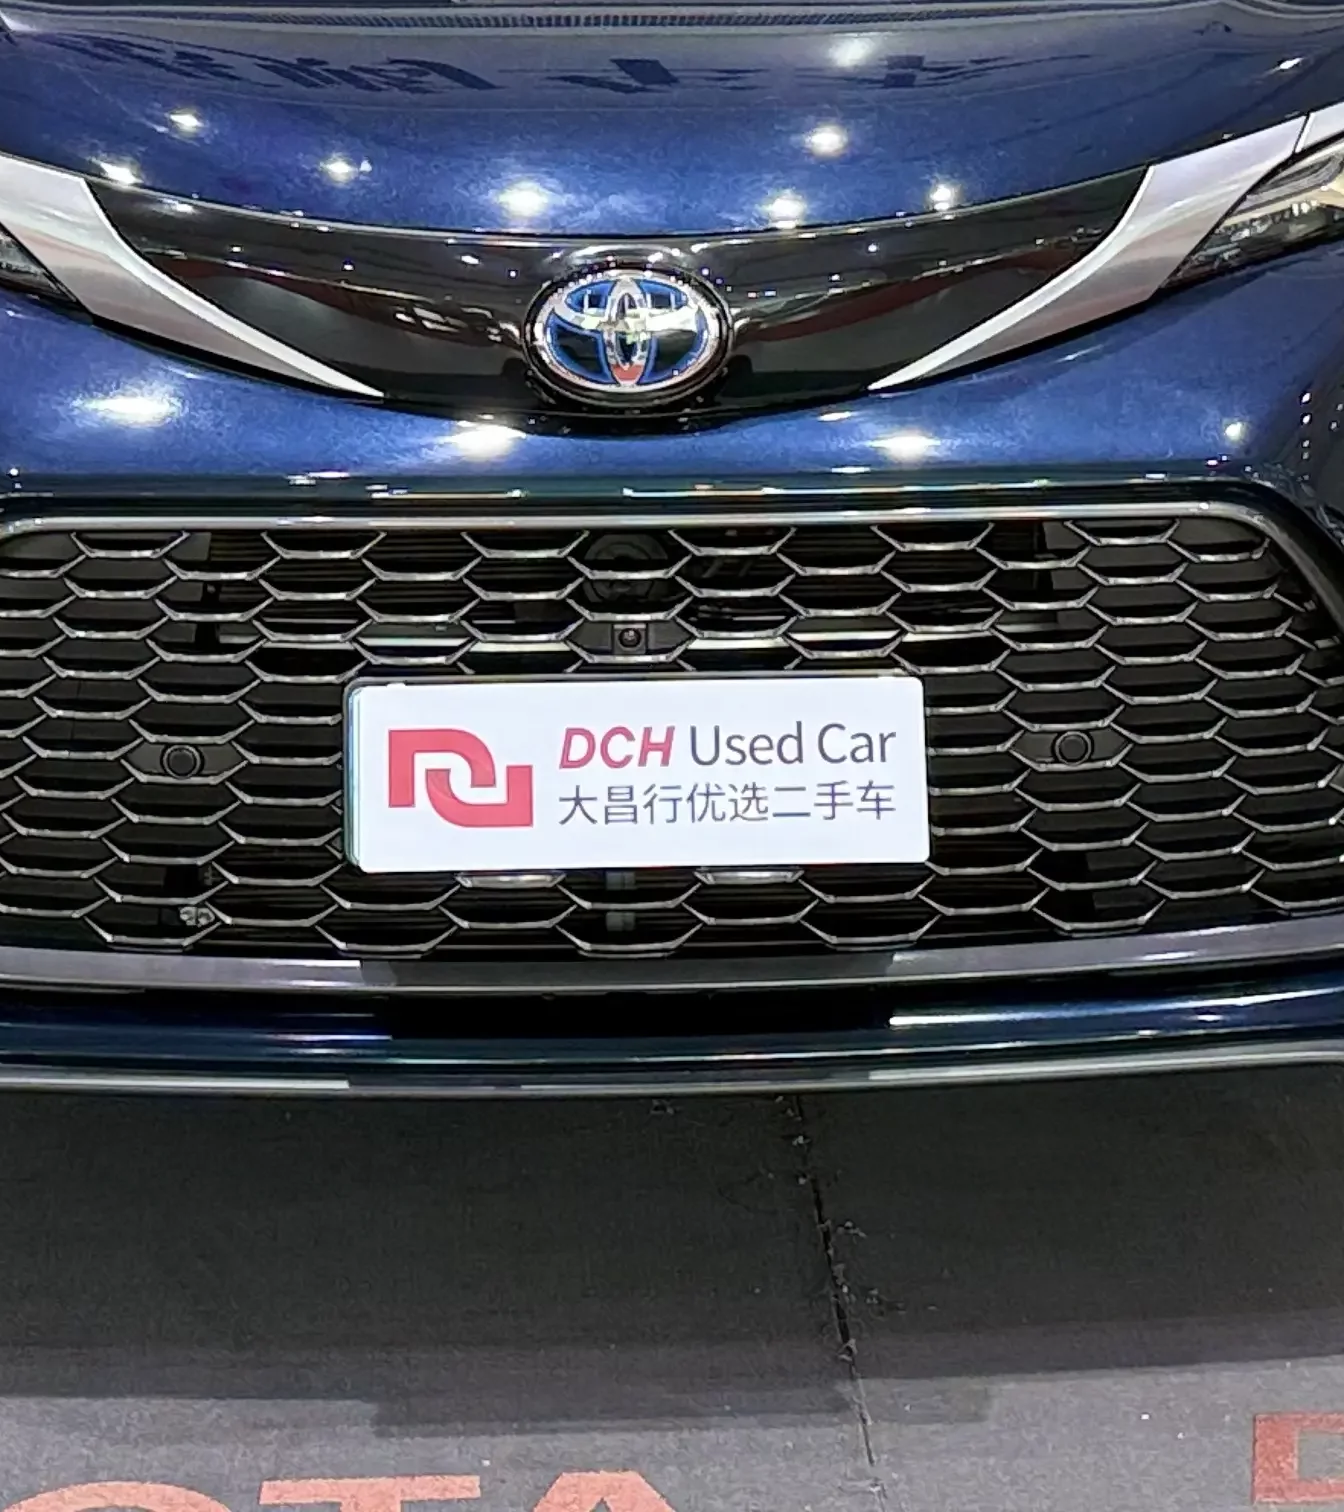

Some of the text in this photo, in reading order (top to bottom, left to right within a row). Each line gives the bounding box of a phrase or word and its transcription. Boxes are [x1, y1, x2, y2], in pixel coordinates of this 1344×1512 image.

[560, 721, 897, 769] DCH Used Car
[558, 781, 897, 826] 大昌行优选二手车
